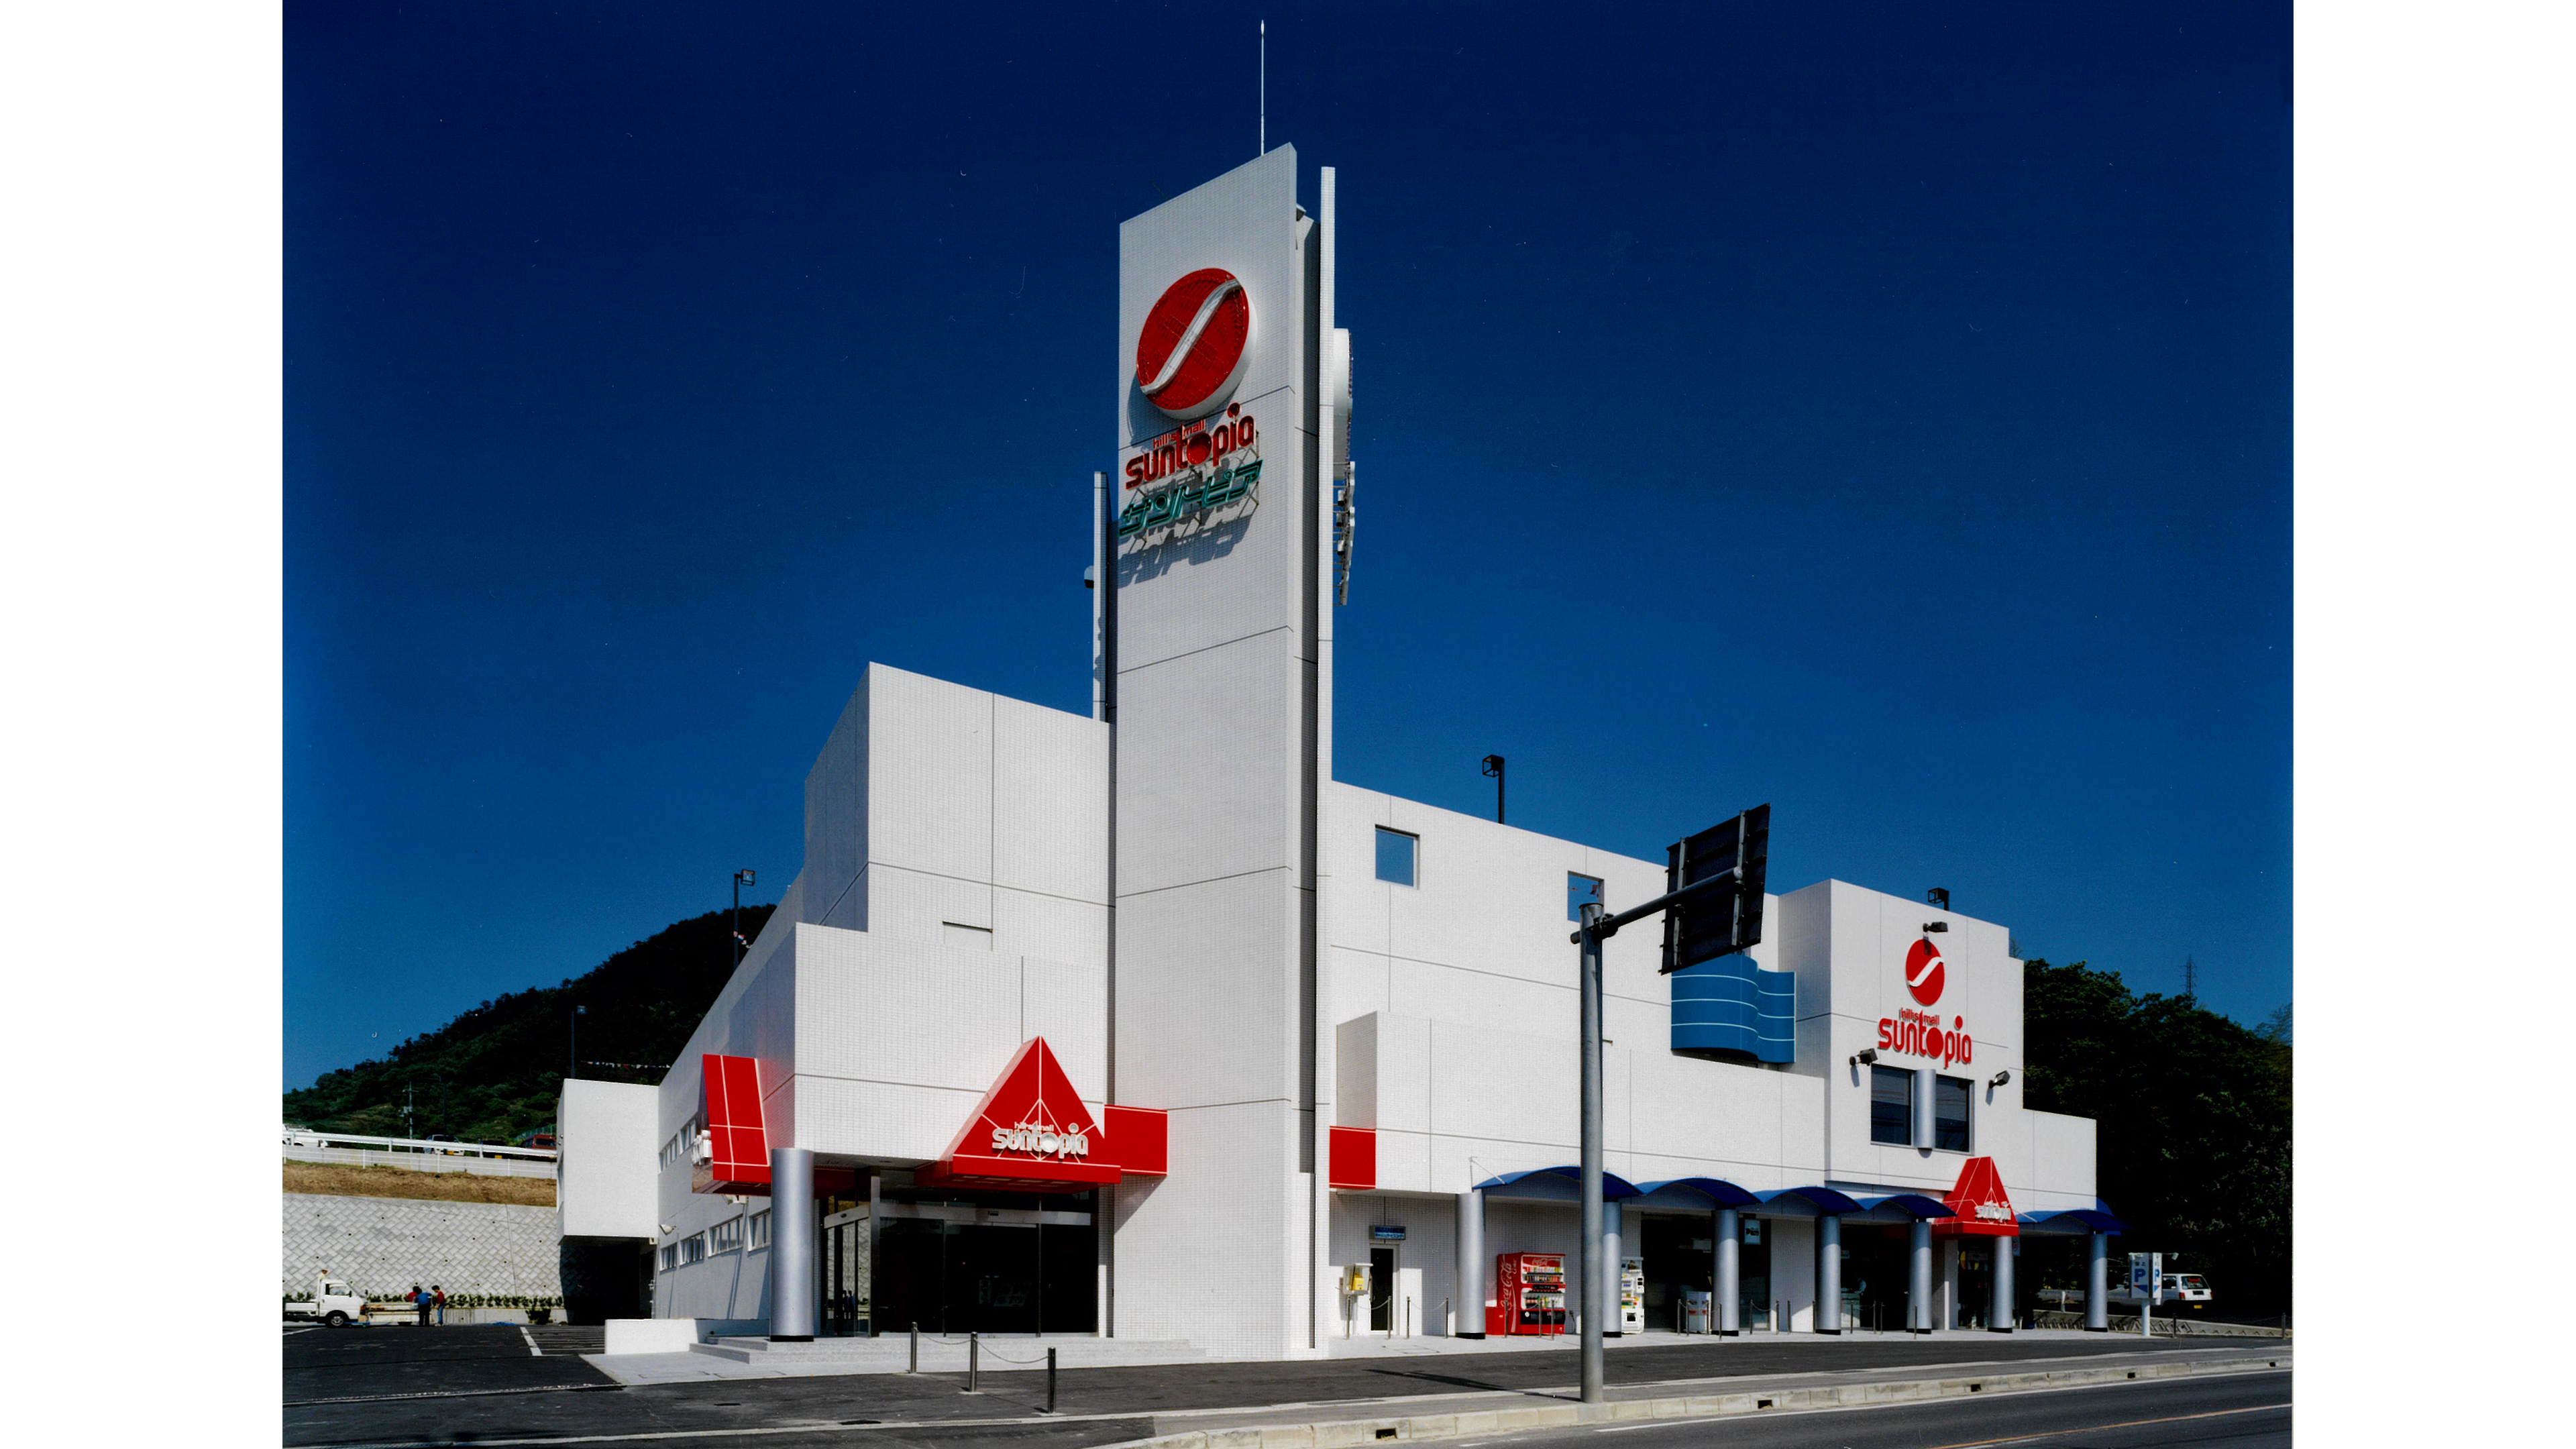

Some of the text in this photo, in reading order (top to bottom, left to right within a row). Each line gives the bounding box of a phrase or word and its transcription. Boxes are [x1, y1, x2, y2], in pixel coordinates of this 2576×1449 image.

[1183, 419, 1205, 436] mall
[1126, 402, 1254, 490] suntopia
[1118, 460, 1263, 537] サントピア
[1923, 1014, 1940, 1026] mall
[1878, 1010, 1972, 1068] suntopia
[992, 1120, 1088, 1159] suntopia
[2135, 1269, 2146, 1282] P
[2155, 1269, 2160, 1282] P
